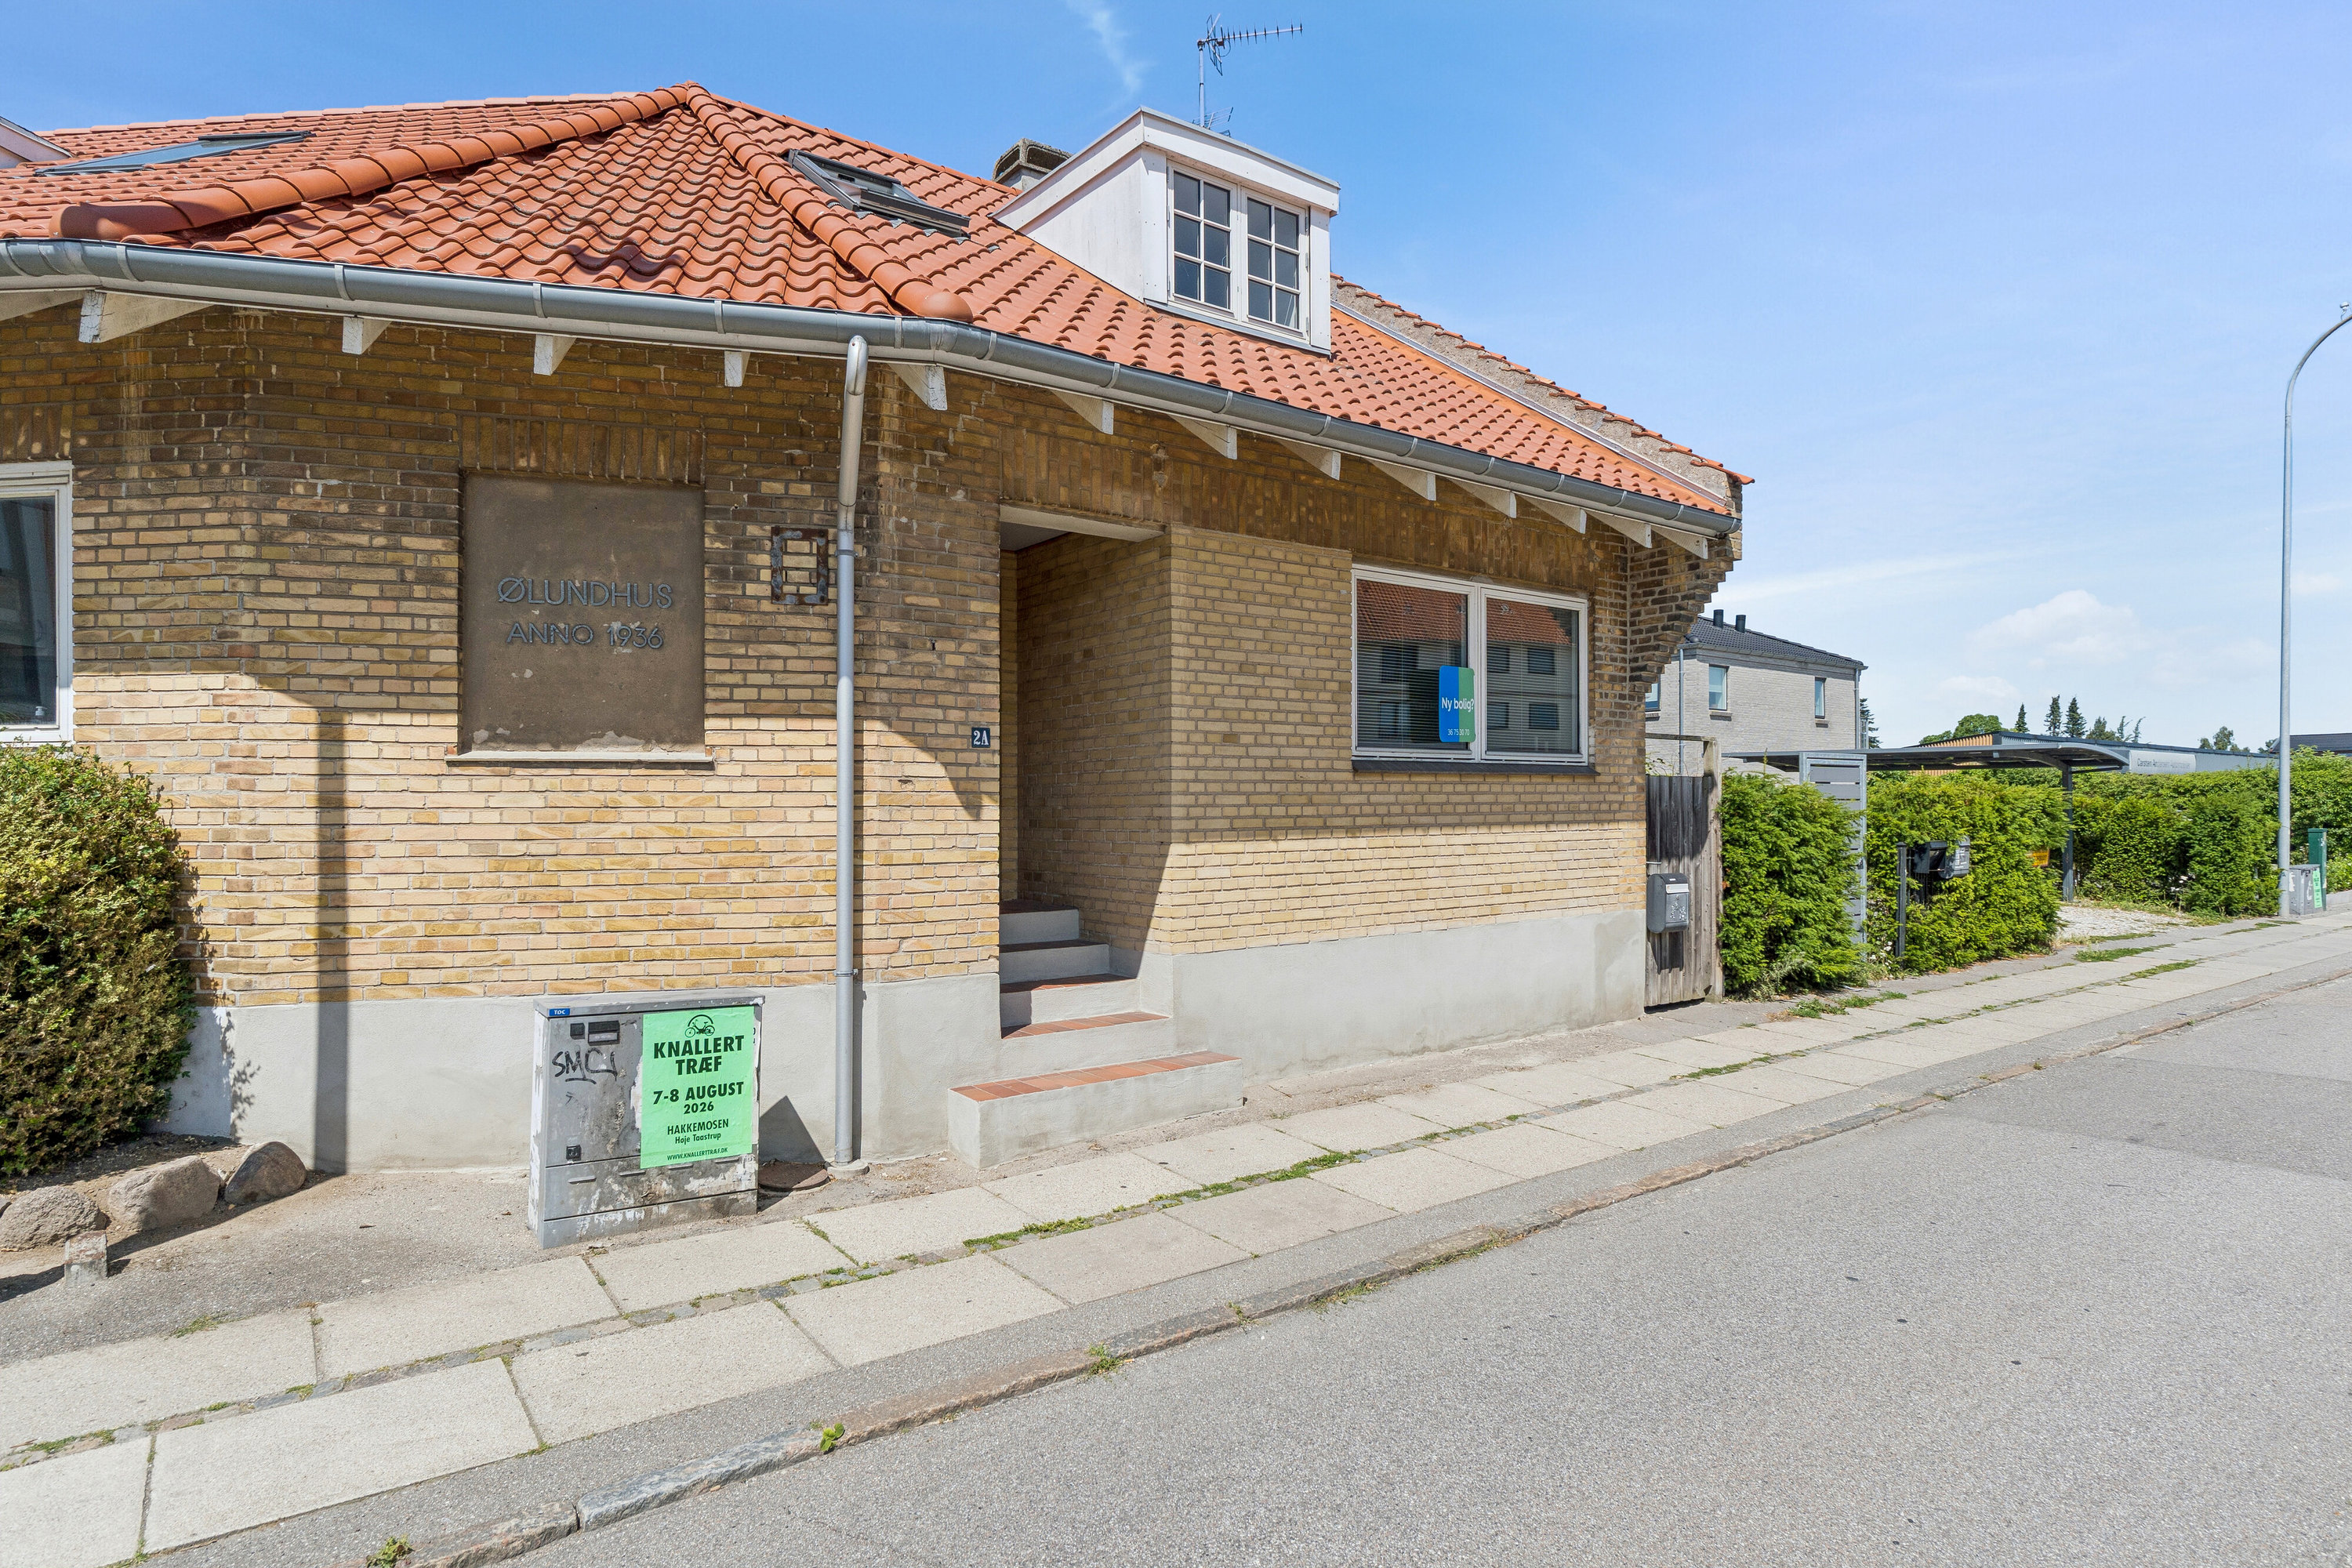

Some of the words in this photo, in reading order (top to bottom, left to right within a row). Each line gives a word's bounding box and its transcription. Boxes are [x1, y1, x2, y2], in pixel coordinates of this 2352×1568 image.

[497, 577, 673, 608] ØLUNDHUS
[506, 622, 594, 644] ANNO
[607, 626, 664, 649] 1936
[1442, 697, 1452, 712] Ny
[1454, 697, 1475, 713] bolig?
[973, 730, 989, 745] 2A
[653, 1035, 745, 1059] KNALLERT
[675, 1055, 722, 1076] TRÆF
[652, 1088, 680, 1105] 7-8
[684, 1081, 744, 1102] AUGUST
[683, 1102, 714, 1115] 2026
[667, 1118, 729, 1135] HAKKEMOSEN
[692, 1132, 721, 1142] Taastrup
[667, 1147, 728, 1160] WWW.KNALLERTTRÆF.DK
